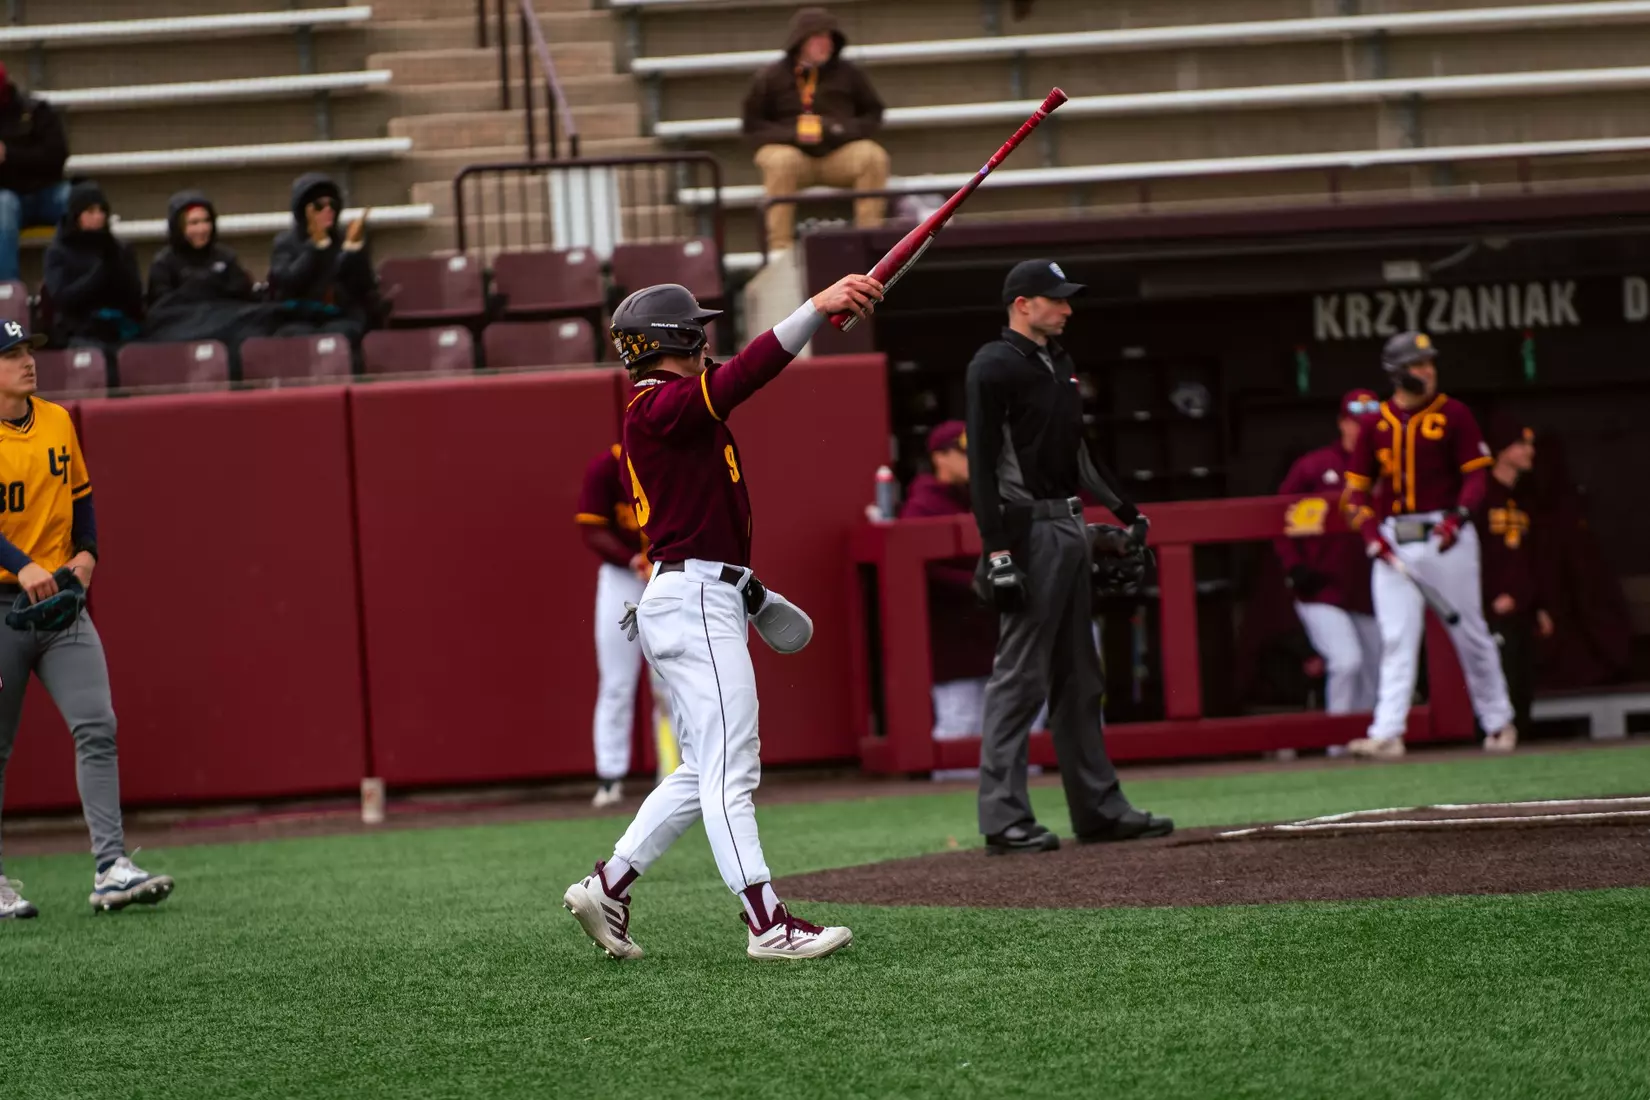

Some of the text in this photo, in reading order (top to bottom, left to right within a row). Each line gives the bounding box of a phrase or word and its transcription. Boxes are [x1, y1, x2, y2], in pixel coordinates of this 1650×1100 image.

[1314, 276, 1650, 340] KRZYZANIAK D
[1421, 412, 1447, 440] C
[724, 444, 740, 483] 9
